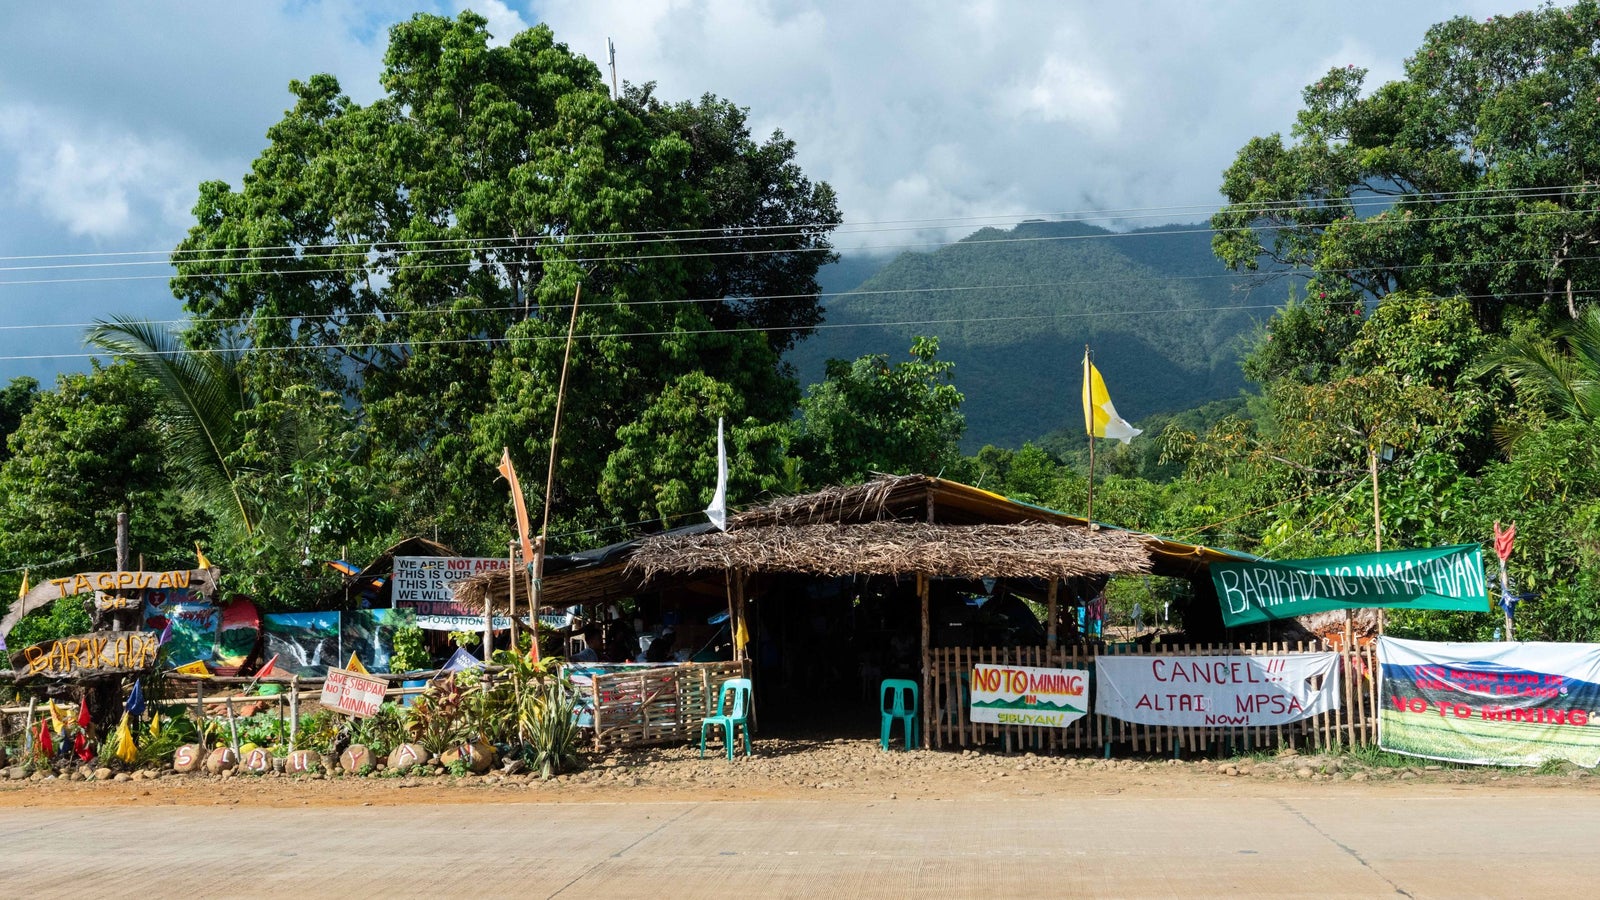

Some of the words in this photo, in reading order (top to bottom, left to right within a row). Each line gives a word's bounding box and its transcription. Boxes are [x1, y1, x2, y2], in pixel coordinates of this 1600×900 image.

[398, 560, 416, 569] WE
[420, 561, 445, 570] ARE
[447, 560, 471, 570] NOT
[475, 560, 510, 570] AFRA
[398, 570, 425, 578] THIS
[429, 570, 441, 579] IS
[444, 570, 471, 580] OUR
[1220, 568, 1329, 614] BARIKADA
[1326, 566, 1358, 597] NG
[1356, 551, 1485, 597] MAMAMAYAN
[52, 569, 191, 597] TAGPUAN
[398, 580, 427, 589] THIS
[432, 580, 444, 589] IS
[398, 590, 418, 599] WE
[421, 590, 451, 600] WILL
[416, 602, 430, 614] TO
[24, 635, 156, 675] BARIKADA
[328, 672, 348, 686] SAVE
[348, 677, 387, 697] SIBUYAN
[972, 668, 1002, 692] NO
[1001, 669, 1029, 694] TO
[1029, 674, 1084, 696] MINING
[1451, 669, 1498, 683] MORE
[1503, 673, 1539, 684] FUN
[1544, 674, 1563, 686] IN
[325, 683, 339, 694] NO
[341, 687, 351, 696] TO
[1496, 684, 1559, 699] ISLAND
[338, 695, 378, 716] MINING
[1025, 695, 1037, 705] IN
[1135, 694, 1205, 712] ALTAI
[1236, 694, 1304, 715] MPSA
[1391, 695, 1428, 714] NO
[1434, 701, 1472, 719] TO
[1481, 704, 1588, 727] MINING
[997, 712, 1065, 727] SIBUYAN!
[1205, 714, 1250, 726] NOW!
